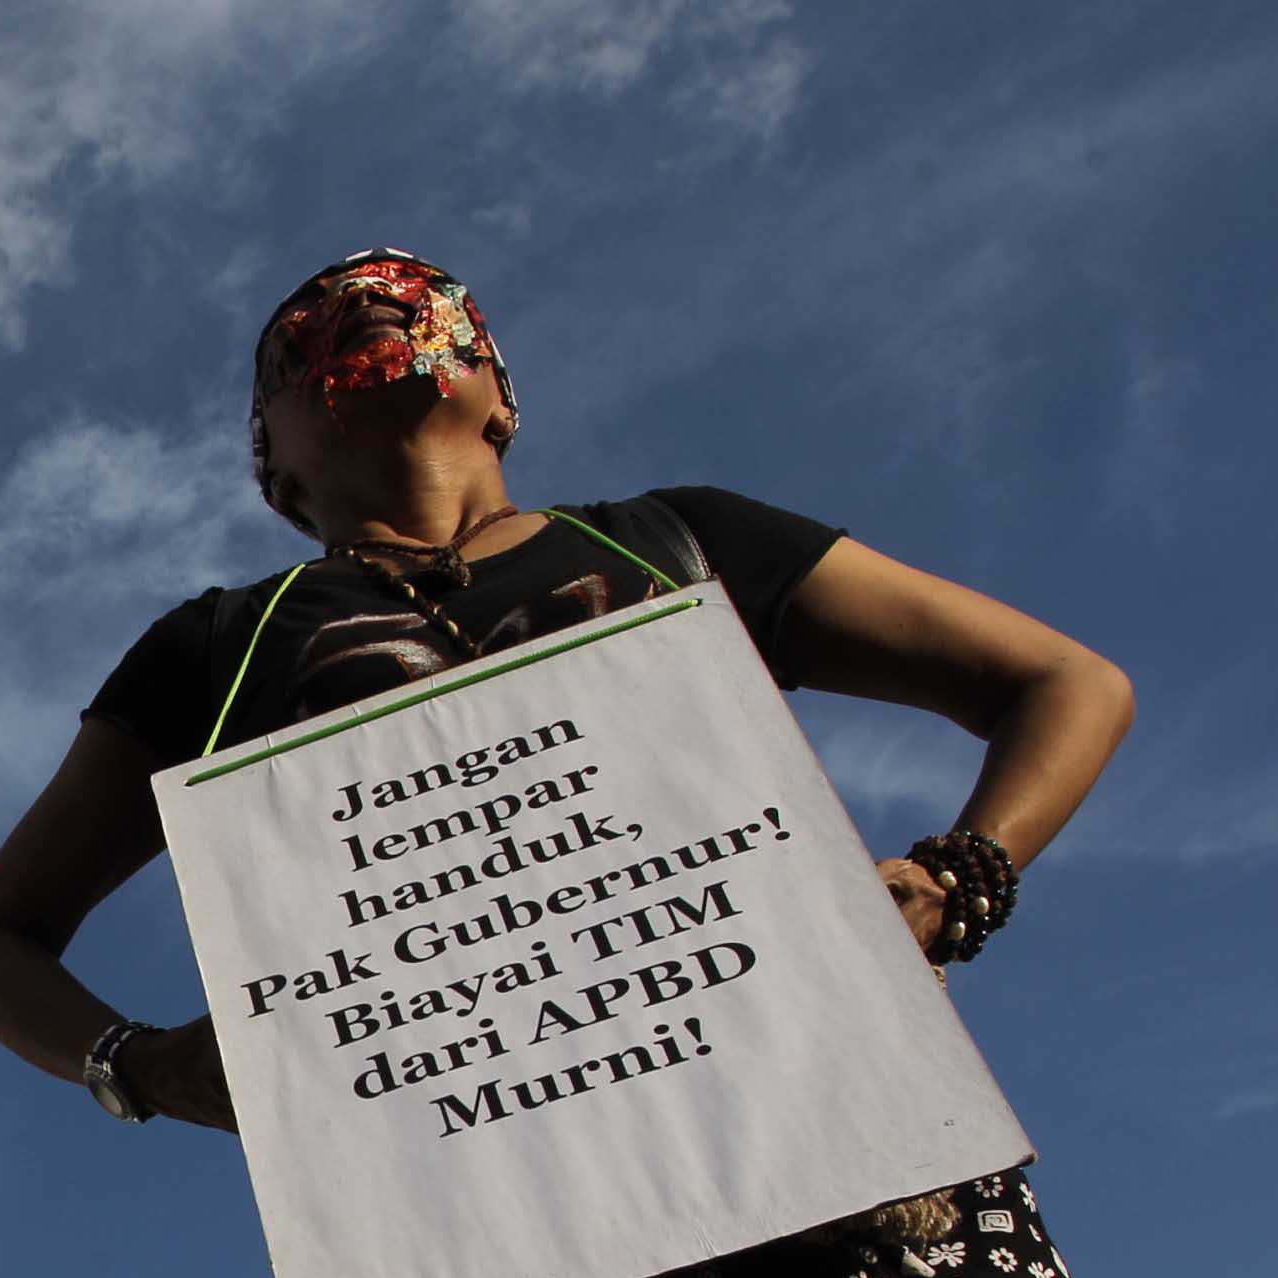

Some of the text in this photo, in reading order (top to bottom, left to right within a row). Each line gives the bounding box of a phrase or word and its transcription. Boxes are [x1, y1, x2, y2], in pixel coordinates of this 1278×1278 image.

[332, 719, 584, 822] Jangan
[349, 764, 599, 871] lempar
[241, 807, 791, 1018] Pak Gubernur!
[338, 815, 644, 926] handuk,
[326, 881, 743, 1048] Biayai TIM
[353, 942, 757, 1100] dari APBD
[430, 1018, 712, 1138] Murni!
